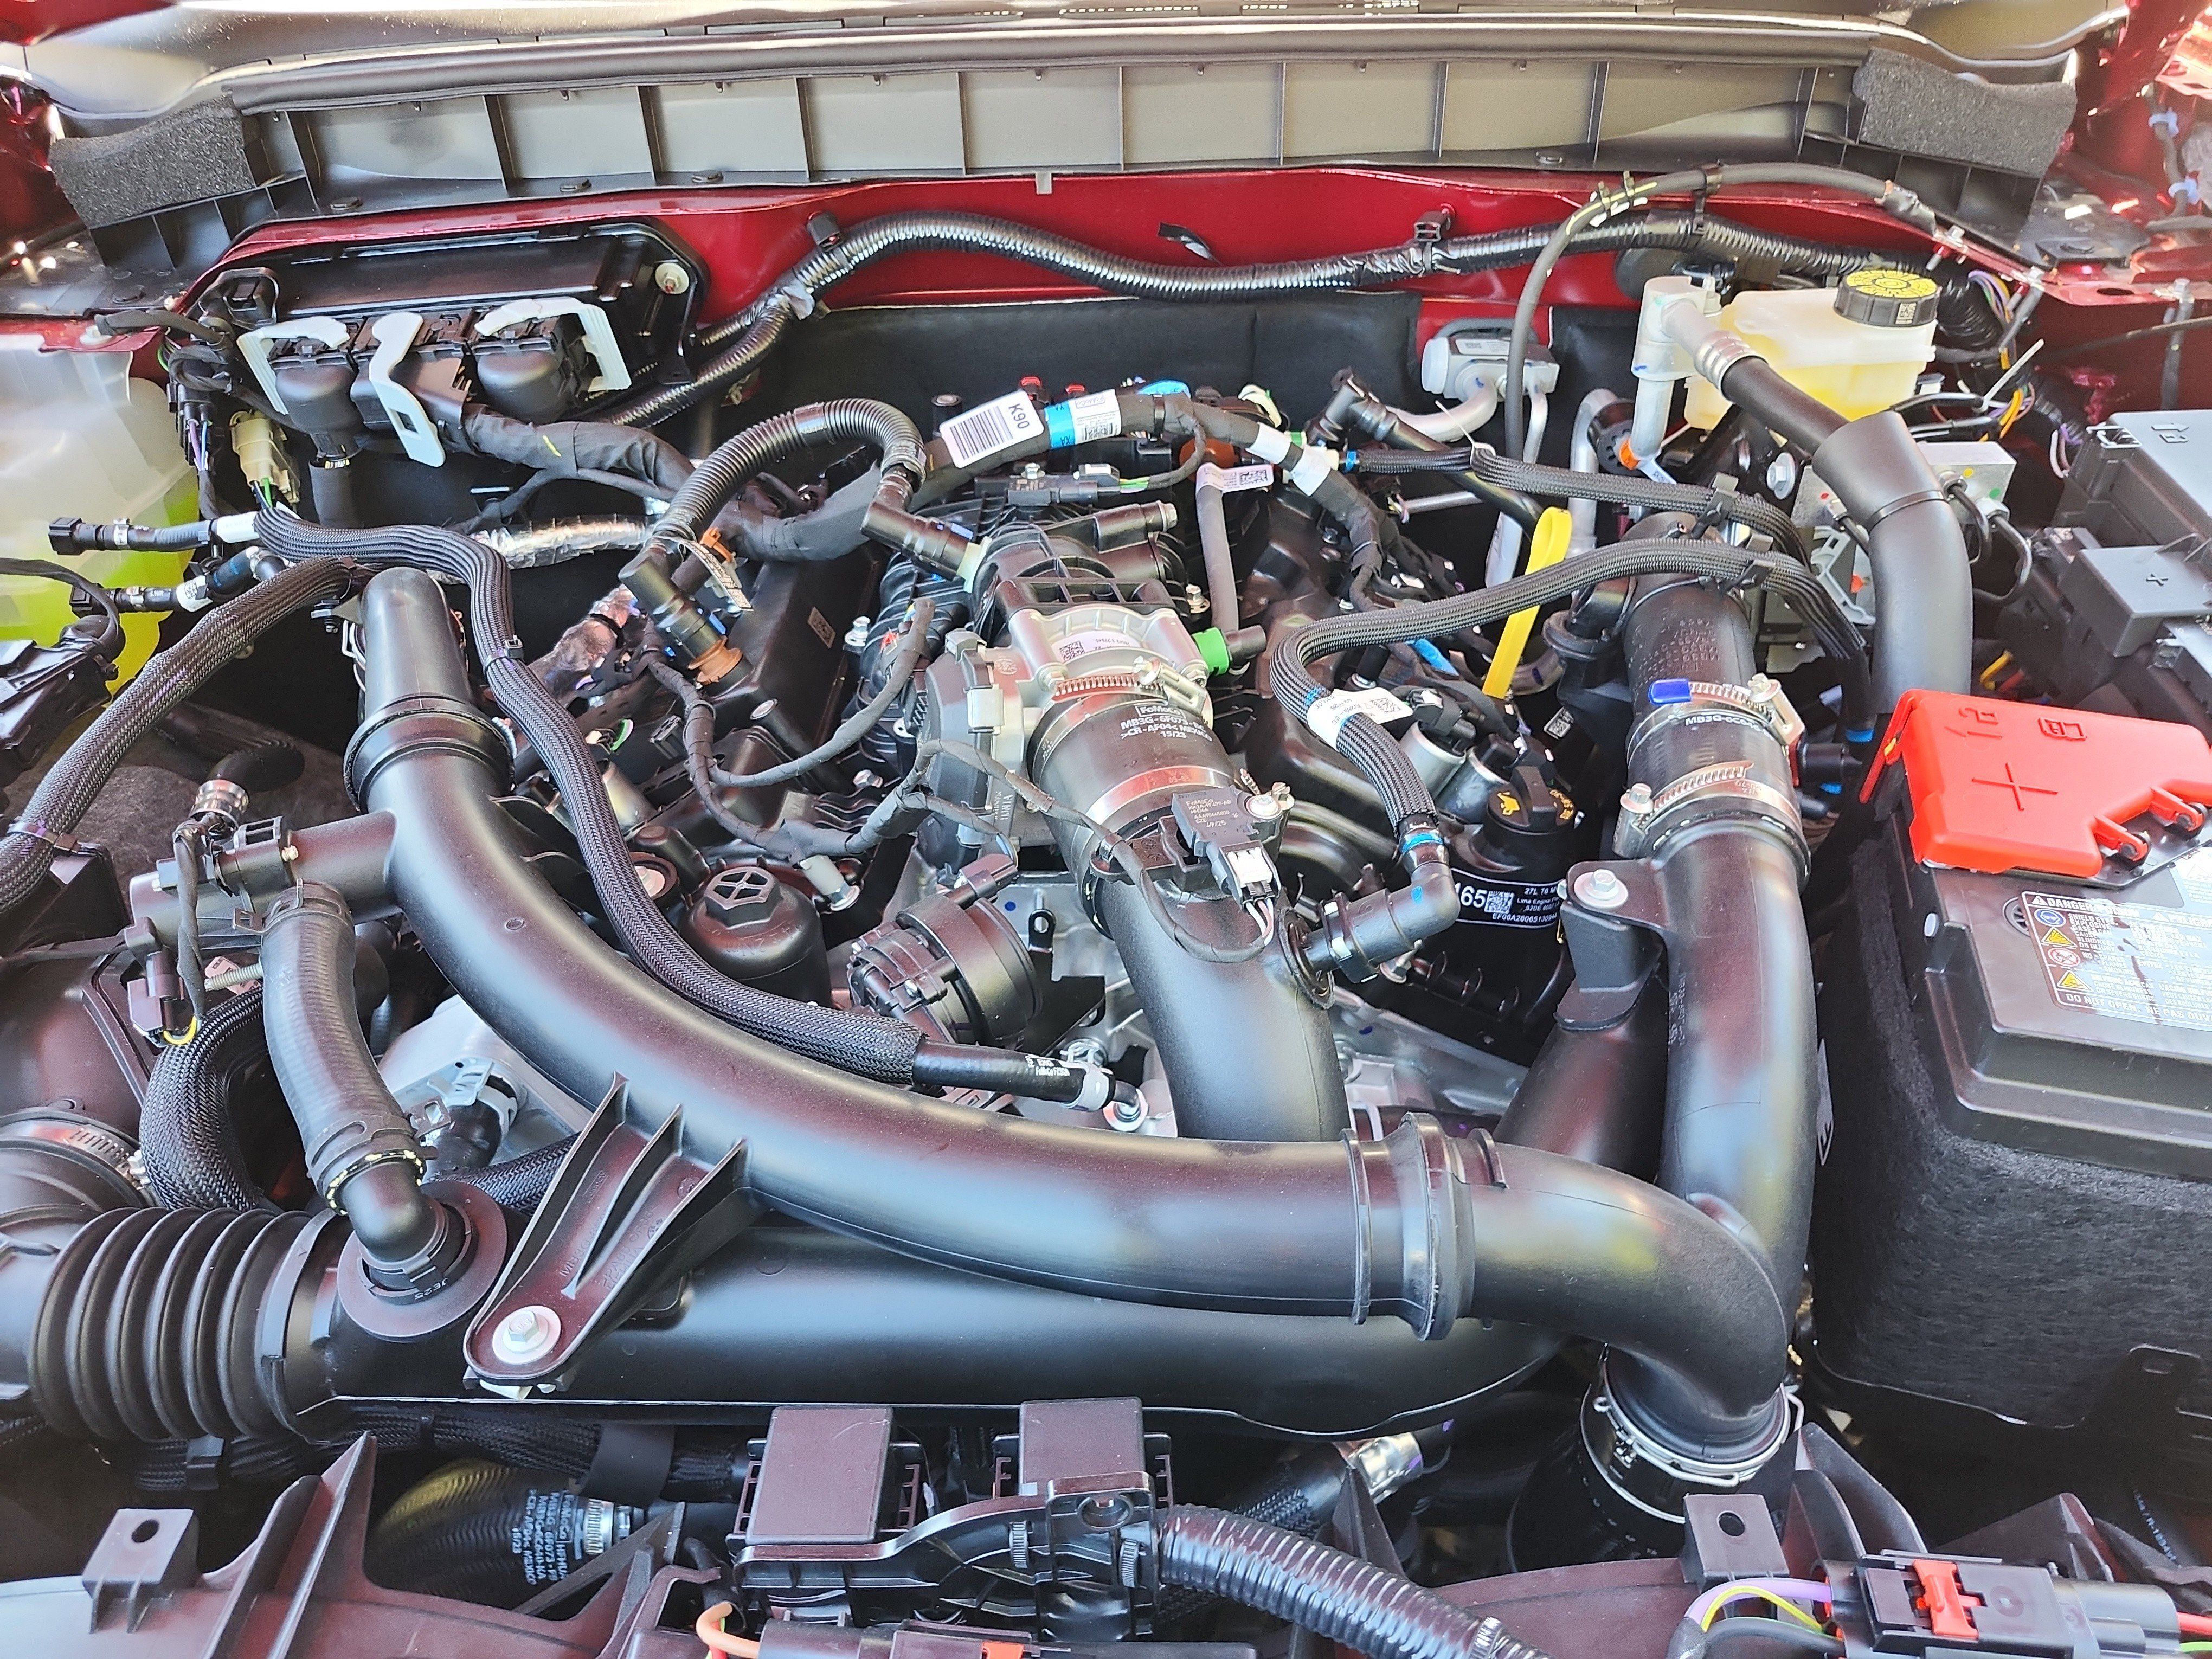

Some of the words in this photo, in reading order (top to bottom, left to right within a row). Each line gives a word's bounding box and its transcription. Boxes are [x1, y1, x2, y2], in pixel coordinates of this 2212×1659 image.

[1008, 403, 1030, 429] K90
[1140, 706, 1181, 715] FoMoCo
[2066, 912, 2095, 923] SHIELD
[2069, 918, 2112, 930] EXPLOSIVE
[2071, 924, 2098, 934] GASES
[2065, 993, 2081, 1002] DO
[2084, 996, 2105, 1007] NOT
[2108, 1000, 2142, 1012] OPEN.
[2145, 1006, 2160, 1016] NE
[2162, 1009, 2184, 1019] PAS
